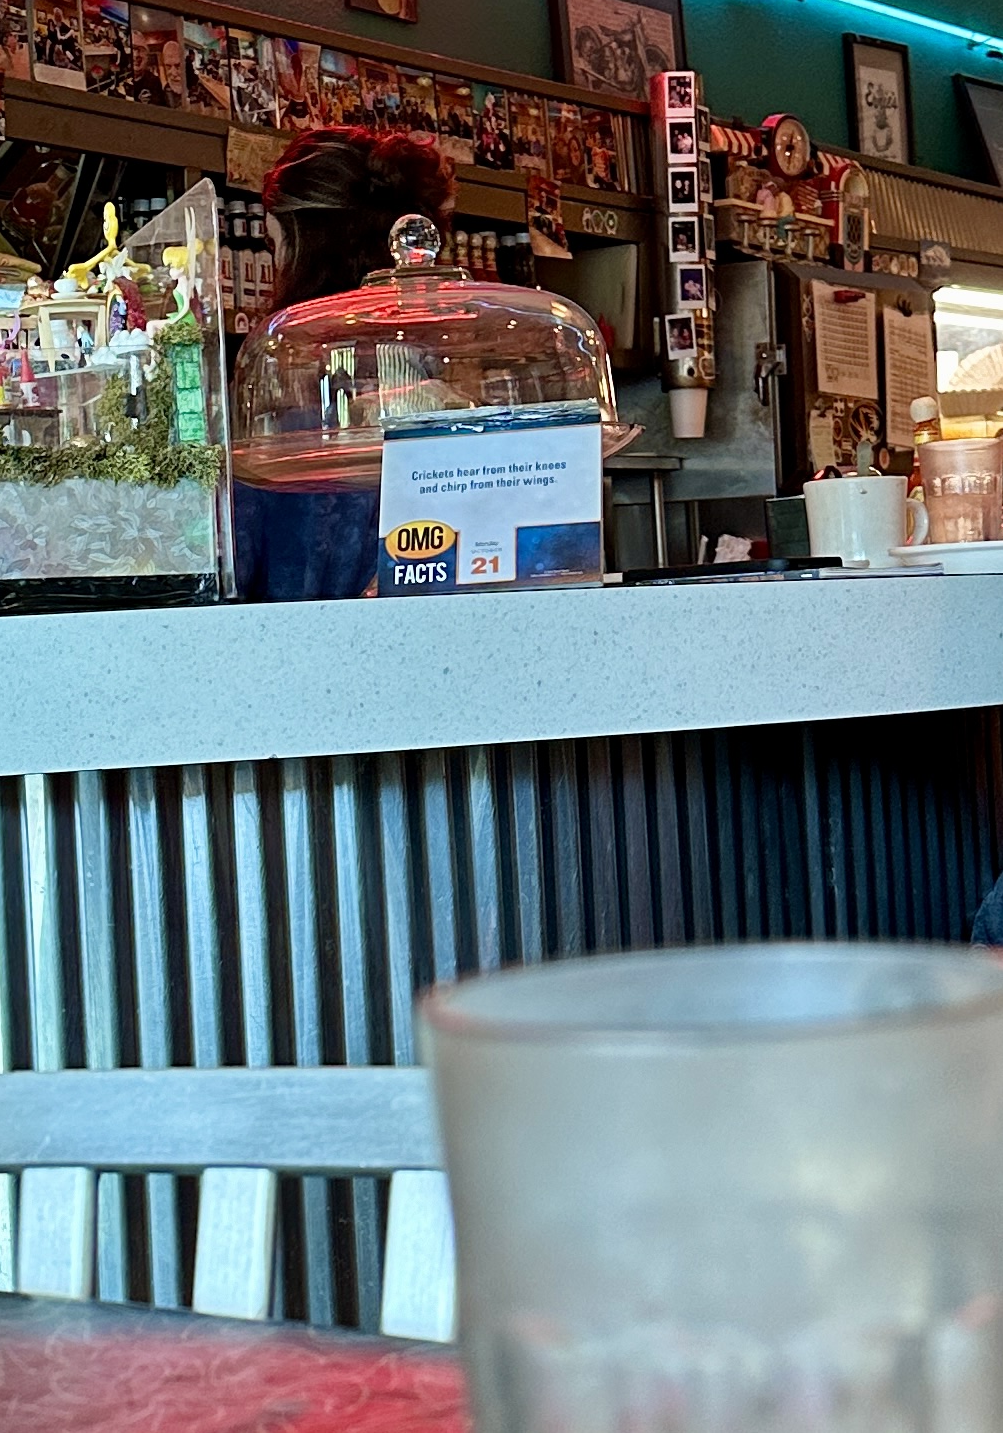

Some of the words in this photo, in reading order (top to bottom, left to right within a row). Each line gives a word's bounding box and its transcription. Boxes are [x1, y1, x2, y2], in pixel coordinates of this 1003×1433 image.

[411, 470, 454, 481] Crickets
[457, 466, 480, 478] hear
[482, 465, 506, 476] from
[509, 463, 533, 474] their
[536, 461, 567, 472] knees
[419, 483, 438, 495] and
[441, 480, 468, 494] chirp
[470, 479, 494, 490] from
[497, 477, 521, 488] their
[523, 475, 558, 488] wings.
[397, 525, 444, 552] OMG
[394, 561, 447, 585] FACTS
[470, 556, 499, 575] 21
